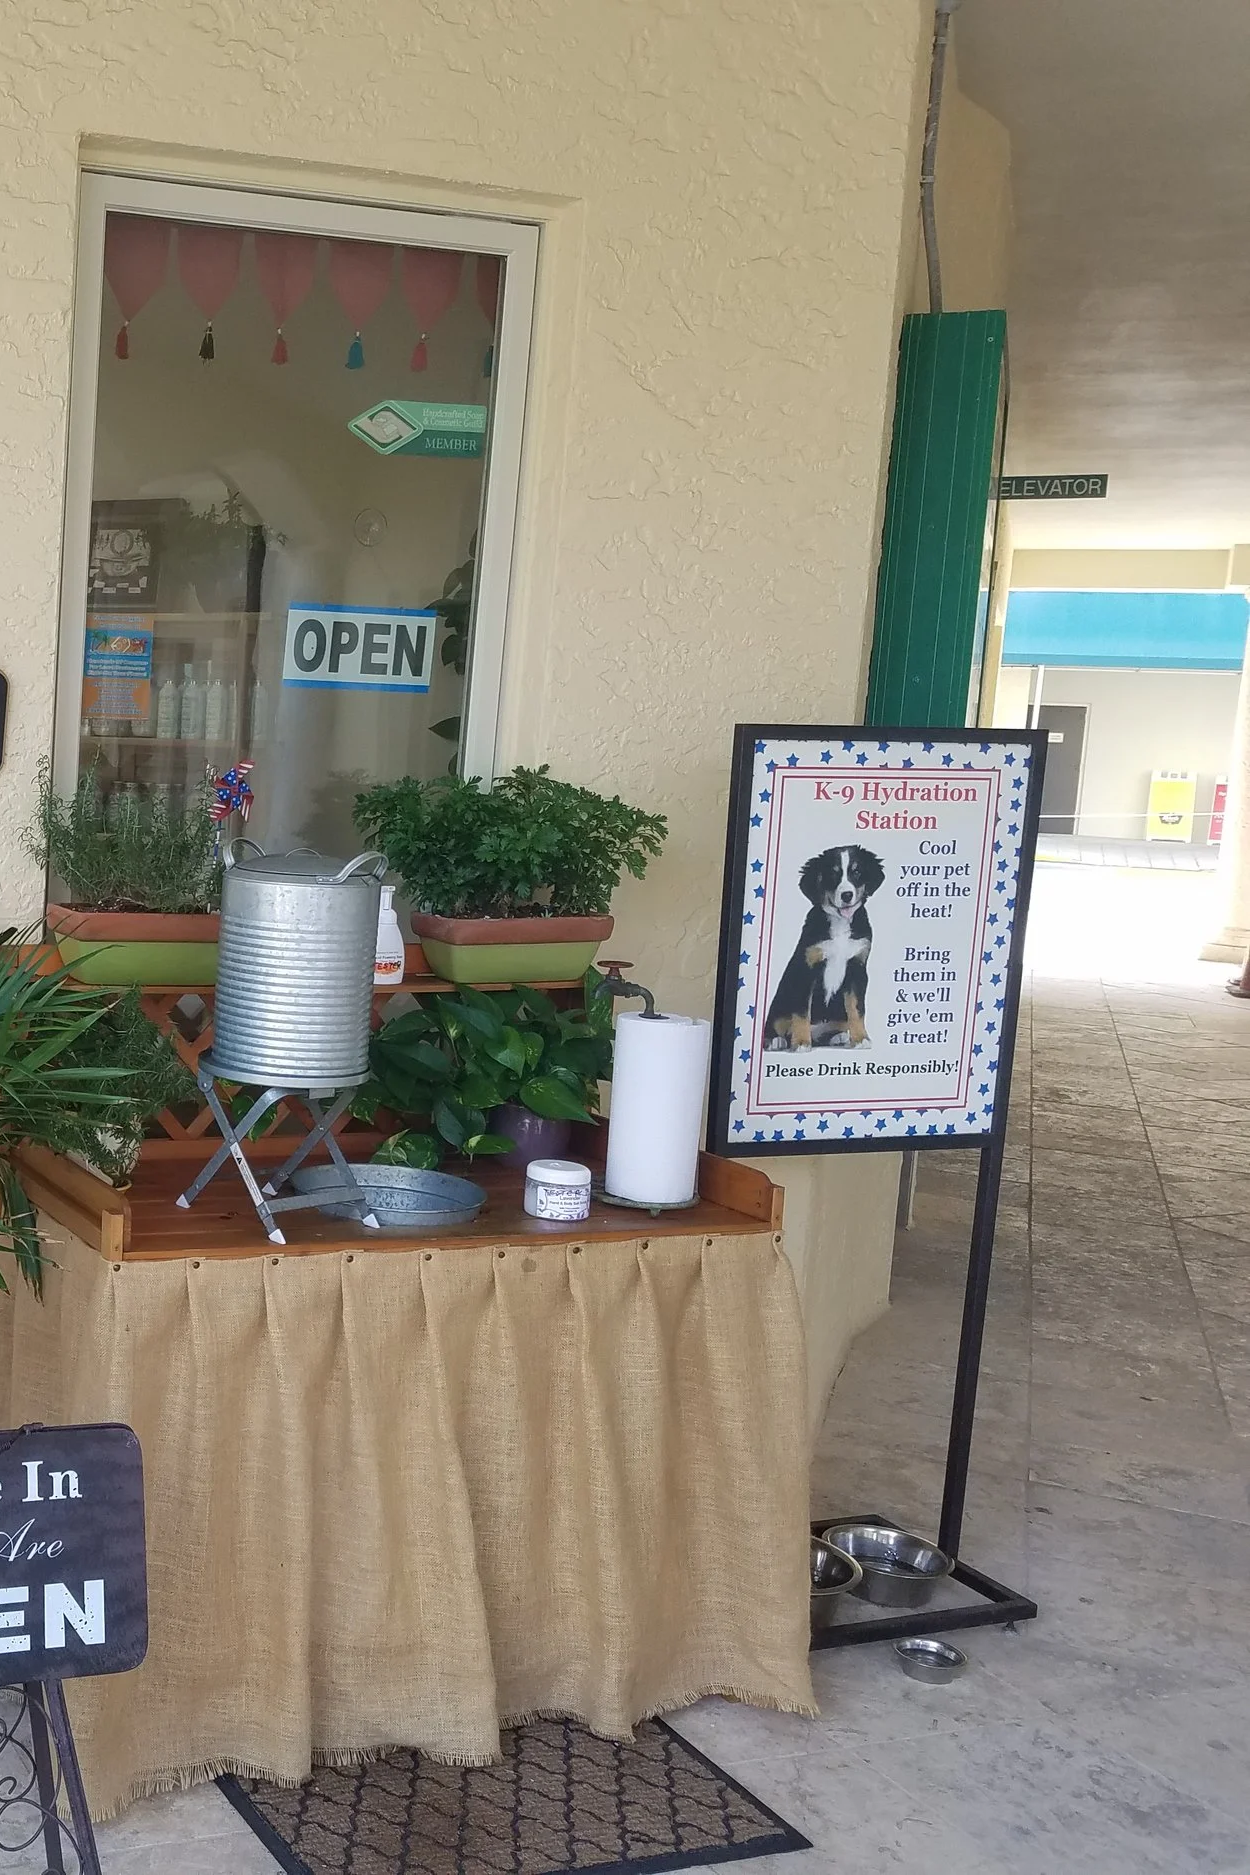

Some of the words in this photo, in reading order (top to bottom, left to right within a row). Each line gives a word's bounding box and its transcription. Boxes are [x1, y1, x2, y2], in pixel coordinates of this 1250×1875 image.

[424, 437, 477, 451] MEMBER
[1001, 479, 1101, 496] ELEVATOR
[293, 618, 427, 677] OPEN
[813, 781, 855, 805] K-9
[861, 780, 978, 806] Hydration
[855, 810, 938, 830] Station
[919, 840, 957, 855] Cool
[900, 865, 940, 879] your
[943, 863, 970, 879] pet
[896, 881, 922, 897] off
[924, 882, 940, 897] in
[945, 882, 971, 897] the
[910, 903, 953, 918] heat!
[904, 947, 951, 965] Bring
[893, 968, 936, 982] them
[940, 968, 957, 982] in
[895, 988, 908, 1003] &
[913, 987, 951, 1002] we'll
[887, 1010, 921, 1027] give
[926, 1009, 954, 1023] 'em
[889, 1034, 898, 1044] a
[903, 1029, 948, 1044] treat!
[765, 1064, 813, 1077] Please
[818, 1062, 861, 1076] Drink
[865, 1060, 960, 1077] Responsibly!
[21, 1460, 83, 1502] In
